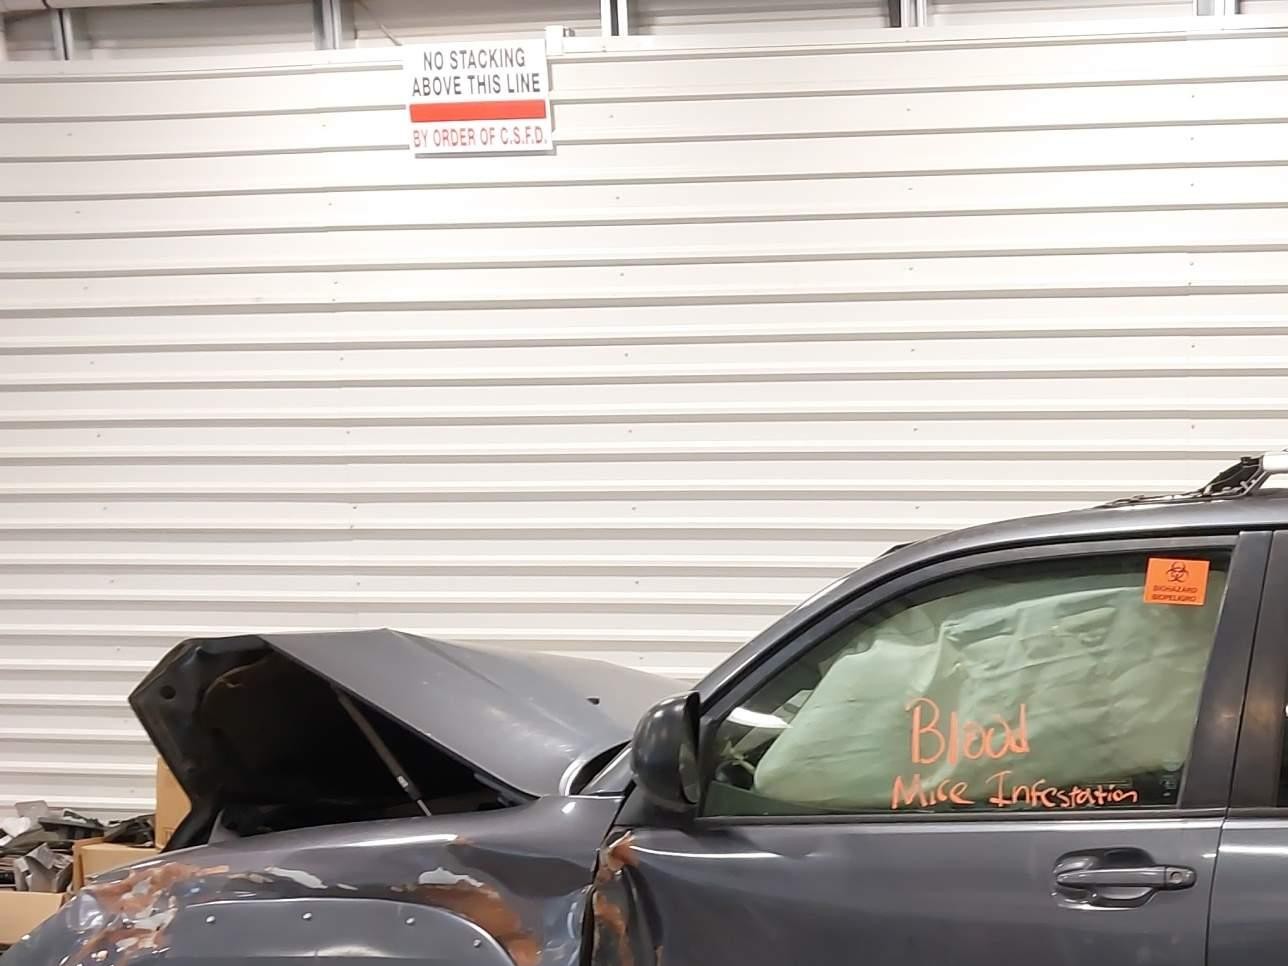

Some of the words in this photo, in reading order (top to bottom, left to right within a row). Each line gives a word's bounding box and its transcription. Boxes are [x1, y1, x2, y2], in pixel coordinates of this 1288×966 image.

[423, 50, 444, 71] NO
[450, 47, 526, 70] STACKING
[412, 75, 462, 96] ABOVE
[467, 74, 501, 95] THIS
[507, 72, 541, 93] LINE
[413, 129, 428, 148] BY
[433, 127, 475, 147] ORDER
[480, 127, 496, 146] OF
[499, 125, 548, 145] C.S.F.D.
[906, 697, 1030, 766] Blood
[891, 773, 975, 809] Mice
[984, 769, 1138, 808] Infestation
